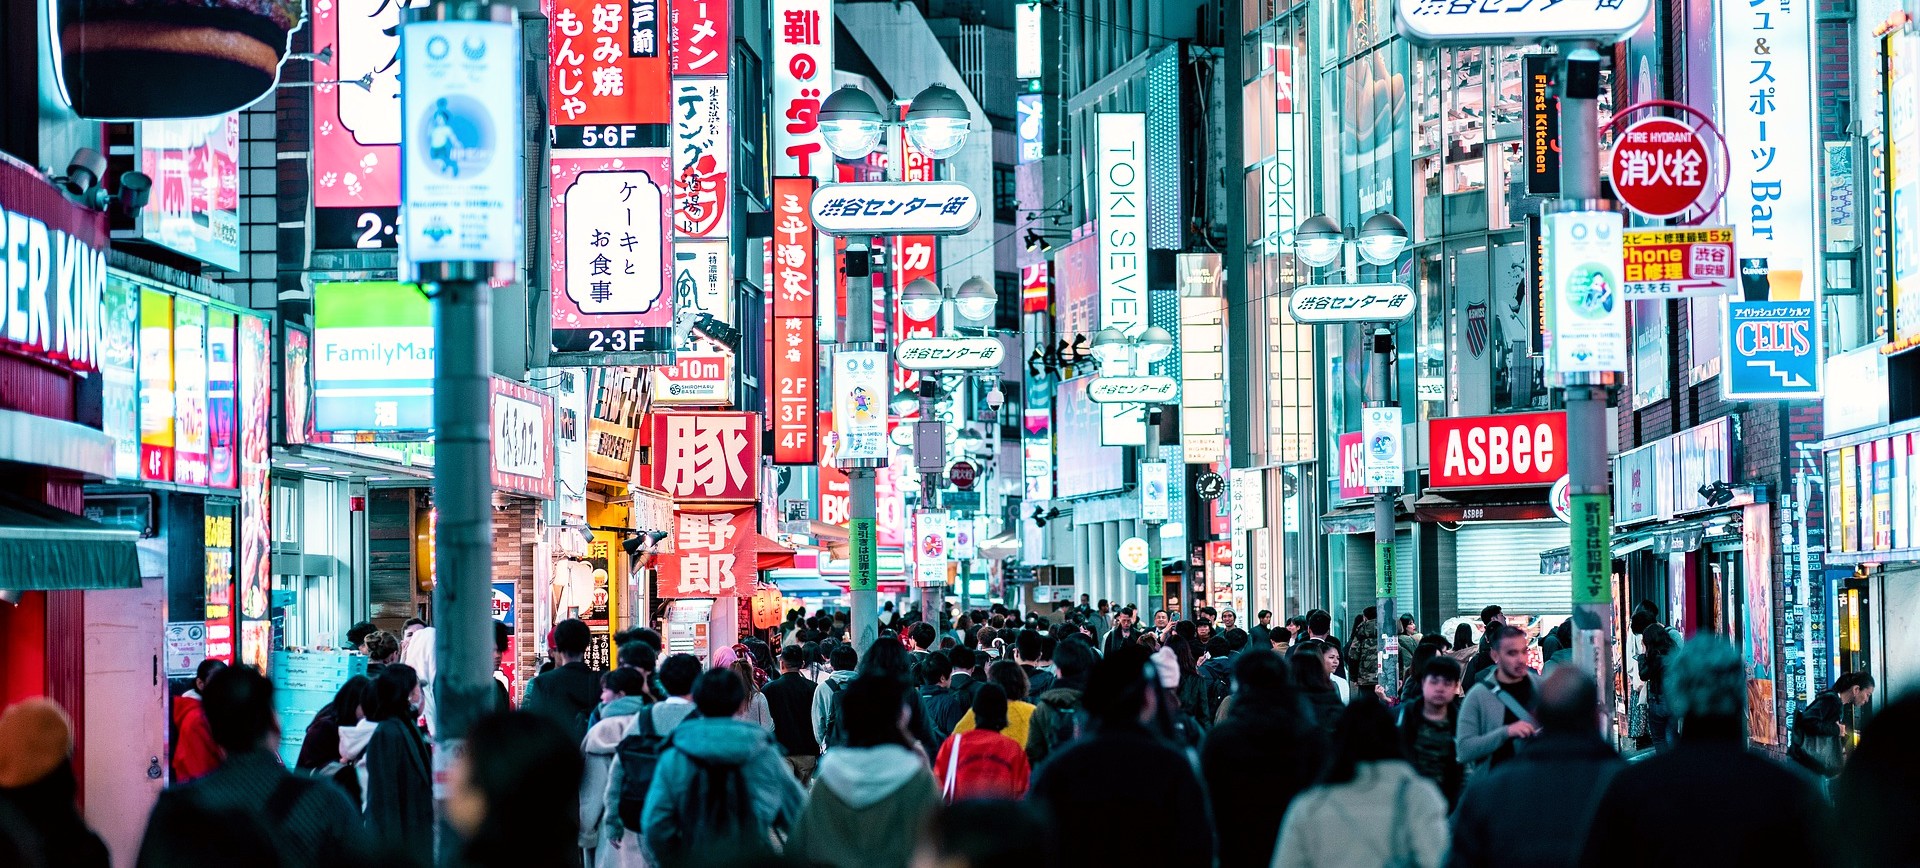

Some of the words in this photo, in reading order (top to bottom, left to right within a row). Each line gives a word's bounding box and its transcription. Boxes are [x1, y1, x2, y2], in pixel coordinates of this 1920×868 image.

[592, 4, 624, 97] 好み焼
[632, 0, 655, 54] 戸前
[688, 0, 719, 70] ーメン
[556, 8, 587, 121] もんじゃ
[1535, 74, 1547, 111] First
[1535, 113, 1548, 174] Kitchen
[1627, 131, 1648, 143] FIRE
[1650, 131, 1692, 143] HYDRANT
[1109, 141, 1136, 218] TOKI
[1619, 149, 1702, 187] 消火栓
[619, 181, 638, 275] ケーキと
[818, 197, 970, 216] 渋谷センター街
[0, 204, 50, 353] ER
[589, 228, 613, 304] お食事
[1695, 247, 1725, 262] 渋谷
[1297, 293, 1409, 310] 渋谷センター街
[903, 347, 997, 359] 渋谷センター街
[1735, 320, 1811, 357] CELTS
[781, 377, 808, 395] 2F
[781, 405, 808, 422] 3F
[781, 432, 808, 449] 4F
[661, 415, 749, 497] 豚
[1443, 423, 1554, 477] ASBee
[1463, 509, 1484, 519] ASBee
[678, 513, 736, 594] 野郎
[858, 522, 870, 586] 客引きは犯罪です
